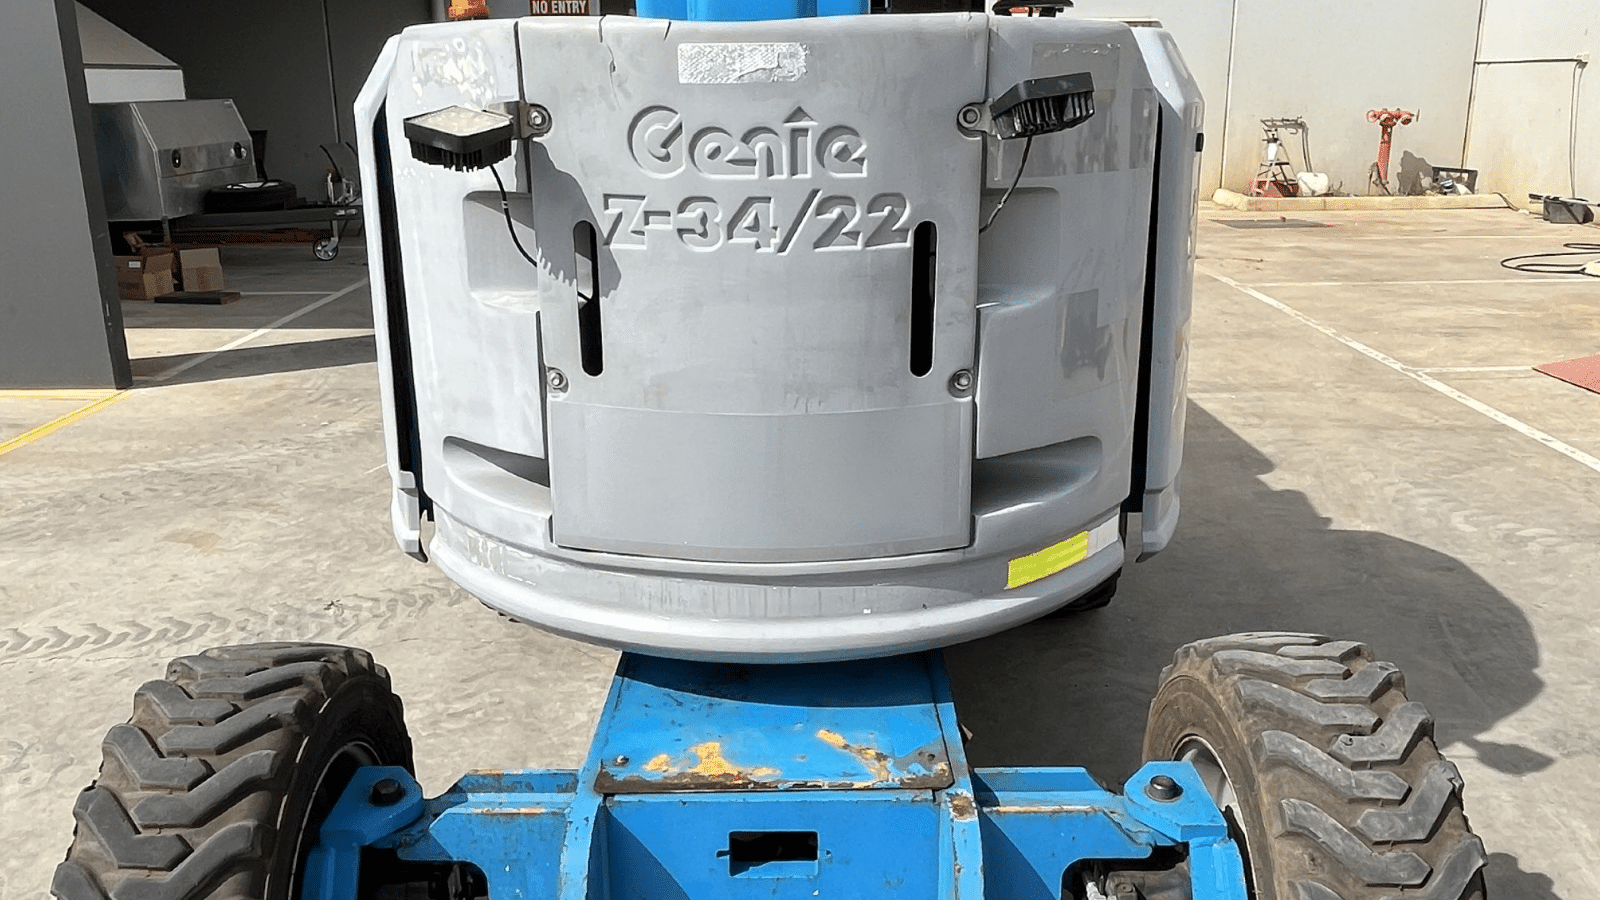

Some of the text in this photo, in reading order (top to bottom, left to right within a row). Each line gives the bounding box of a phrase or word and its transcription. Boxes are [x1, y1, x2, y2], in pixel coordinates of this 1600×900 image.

[532, 0, 587, 14] NO ENTRY
[627, 105, 867, 180] Genie
[602, 188, 911, 256] Z-34/22
